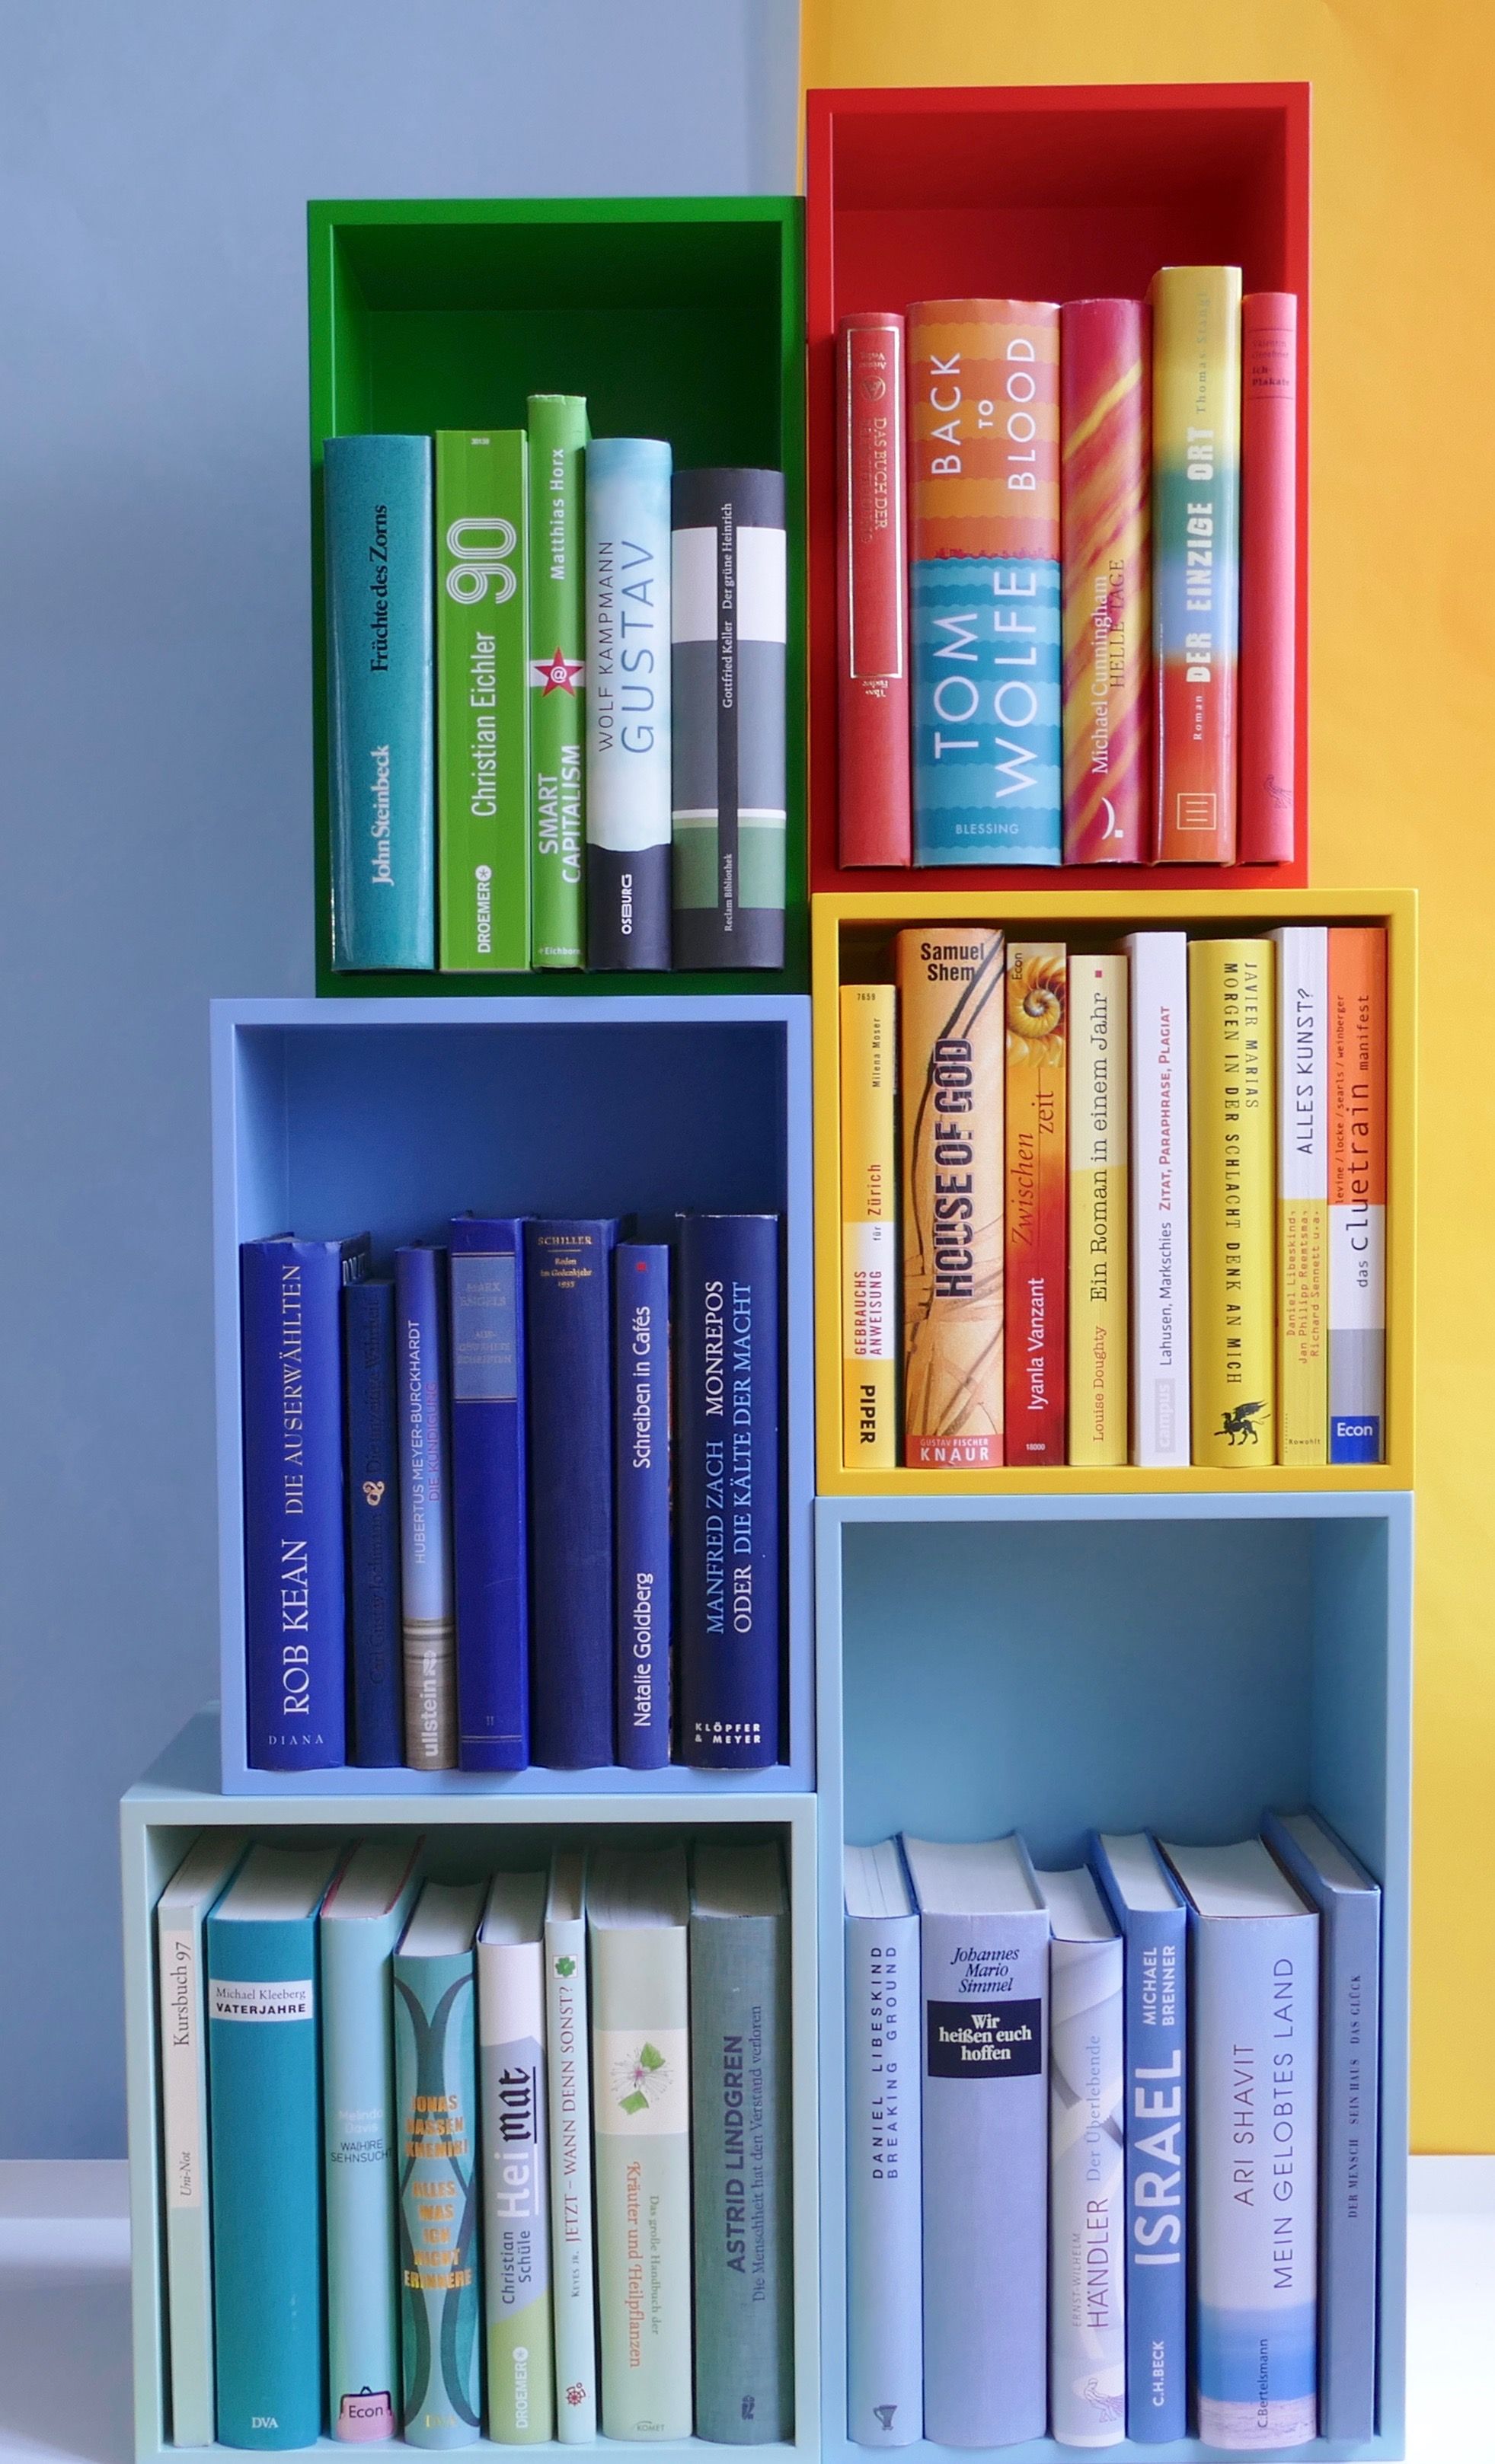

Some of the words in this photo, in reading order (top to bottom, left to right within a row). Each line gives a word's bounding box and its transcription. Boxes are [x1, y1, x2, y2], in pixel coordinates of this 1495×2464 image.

[930, 353, 962, 474] BACK
[979, 401, 993, 428] TO
[1008, 338, 1036, 491] BLOOD
[551, 448, 564, 493] Horx
[1187, 427, 1213, 481] ORT
[370, 506, 388, 563] Zorns
[551, 498, 564, 579] Matthias
[722, 503, 732, 552] Heinrich
[1187, 502, 1212, 610] EINZIGE
[370, 567, 388, 598] des
[446, 518, 516, 605] 90
[722, 555, 734, 586] grüne
[599, 541, 613, 675] KAMPMANN
[722, 589, 732, 609] Der
[370, 601, 389, 672] Früchte
[621, 540, 654, 753] GUSTAV
[723, 621, 733, 653] Keller
[1091, 575, 1113, 694] Cunningham
[1187, 633, 1211, 682] DER
[471, 631, 496, 708] Eichler
[723, 656, 733, 708] Gottfried
[933, 613, 979, 759] TOM
[994, 571, 1038, 798] WOLFE
[599, 688, 613, 752] WOLF
[1091, 698, 1107, 774] Michael
[372, 745, 390, 838] Steinbeck
[471, 716, 496, 817] Christian
[539, 774, 557, 854] SMART
[562, 745, 580, 883] CAPITALISM
[956, 824, 1019, 835] BLESSING
[372, 840, 395, 886] John
[724, 854, 733, 898] Bibliothek
[478, 880, 490, 953] DROEMER
[724, 900, 733, 932] Reclam
[921, 943, 984, 961] Samuel
[928, 963, 974, 981] Shem
[1011, 953, 1022, 980] Econ
[1091, 992, 1107, 1051] Jahr
[1224, 962, 1238, 1043] MORGEN
[1245, 962, 1257, 1025] JAVIER
[872, 1017, 881, 1045] Moser
[1159, 1007, 1171, 1064] PLAGIAT
[1224, 1054, 1239, 1069] IN
[1297, 988, 1313, 1076] KUNST?
[1359, 994, 1369, 1071] manifest
[872, 1050, 881, 1087] Milena
[933, 1038, 973, 1114] GOD
[1091, 1058, 1107, 1131] einem
[1245, 1035, 1257, 1108] MARIAS
[1038, 1090, 1054, 1134] zeit
[1224, 1086, 1239, 1121] DER
[934, 1120, 973, 1166] OF
[1091, 1138, 1107, 1162] in
[867, 1163, 881, 1216] Zürich
[1011, 1132, 1033, 1246] Zwischen
[1225, 1133, 1241, 1228] SCHLACHT
[538, 1236, 593, 1246] SCHILLER
[934, 1173, 973, 1298] HOUSE
[1091, 1170, 1107, 1254] Roman
[1091, 1262, 1107, 1302] Ein
[1160, 1221, 1171, 1298] Markschies
[1225, 1242, 1241, 1291] DENK
[1359, 1261, 1369, 1288] das
[634, 1306, 650, 1355] Cafés
[733, 1282, 752, 1371] MACHT
[855, 1271, 867, 1355] GEBRAUCHS
[870, 1271, 882, 1355] ANWEISUNG
[1027, 1278, 1044, 1351] Vanzant
[1160, 1303, 1173, 1366] Lahusen,
[1226, 1304, 1241, 1329] AN
[282, 1264, 302, 1467] AUSERWÄHLTEN
[634, 1361, 650, 1380] in
[705, 1280, 724, 1416] MONREPOS
[1094, 1326, 1107, 1389] Doughty
[1226, 1338, 1241, 1384] MICH
[408, 1320, 424, 1480] MEYER-BURCKHARDT
[734, 1377, 752, 1427] DER
[861, 1385, 875, 1444] PIPER
[1027, 1358, 1047, 1410] Iyanla
[634, 1384, 650, 1469] Schreiben
[1094, 1394, 1104, 1441] Louise
[1337, 1423, 1373, 1437] Econ
[706, 1441, 724, 1510] ZACH
[731, 1432, 752, 1508] KÄLTE
[921, 1447, 989, 1461] KNAUR
[286, 1473, 302, 1515] DIE
[414, 1484, 426, 1565] HUBERTUS
[734, 1514, 752, 1554] DIE
[283, 1539, 308, 1632] KEAN
[706, 1514, 724, 1635] MANFRED
[734, 1565, 752, 1633] ODER
[634, 1572, 653, 1658] Goldberg
[283, 1644, 309, 1715] ROB
[634, 1662, 651, 1728] Natalie
[268, 1735, 324, 1745] DIANA
[423, 1680, 438, 1758] ullstein
[696, 1722, 760, 1732] KLÖPFER
[713, 1735, 760, 1744] MEYER
[174, 1941, 191, 1961] 97
[951, 1947, 1019, 1963] Johannes
[965, 1963, 1008, 1977] Mario
[171, 1966, 190, 2047] Kursbuch
[216, 1987, 257, 2000] Michael
[260, 1989, 305, 2003] Kleeberg
[216, 2003, 305, 2014] VATERJAHRE
[871, 1945, 883, 2071] LIBESKIND
[887, 1947, 897, 2039] GROUND
[959, 1978, 1013, 1993] Simmel
[1143, 1947, 1156, 2025] MICHAEL
[1163, 1945, 1175, 2025] BRENNER
[1274, 1958, 1293, 2039] LAND
[557, 1986, 573, 2054] SONST?
[938, 2028, 992, 2043] heißen
[995, 2026, 1031, 2041] euch
[972, 2013, 1000, 2029] Wir
[961, 2044, 1011, 2061] hoffen
[1350, 2059, 1359, 2092] HAUS
[560, 2060, 575, 2112] DENN
[724, 2035, 742, 2169] LINDGREN
[1234, 2044, 1254, 2144] SHAVIT
[1350, 2096, 1359, 2124] SEIN
[562, 2120, 577, 2177] WANN
[872, 2096, 883, 2179] DANIEL
[887, 2062, 897, 2179] BREAKING
[1274, 2054, 1293, 2201] GELOBTES
[1135, 2050, 1181, 2265] ISRAEL
[1234, 2156, 1254, 2205] ARI
[1349, 2140, 1358, 2188] MENSCH
[565, 2192, 579, 2242] JETZT
[626, 2162, 640, 2224] Kräuter
[1348, 2195, 1357, 2218] DER
[518, 2229, 531, 2283] Schüle
[628, 2228, 640, 2261] und
[726, 2179, 744, 2274] ASTRID
[1274, 2215, 1293, 2290] MEIN
[503, 2232, 514, 2305] Christian
[1086, 2198, 1109, 2330] HÄNDLER
[251, 2417, 278, 2428] DVA
[349, 2405, 383, 2418] Econ
